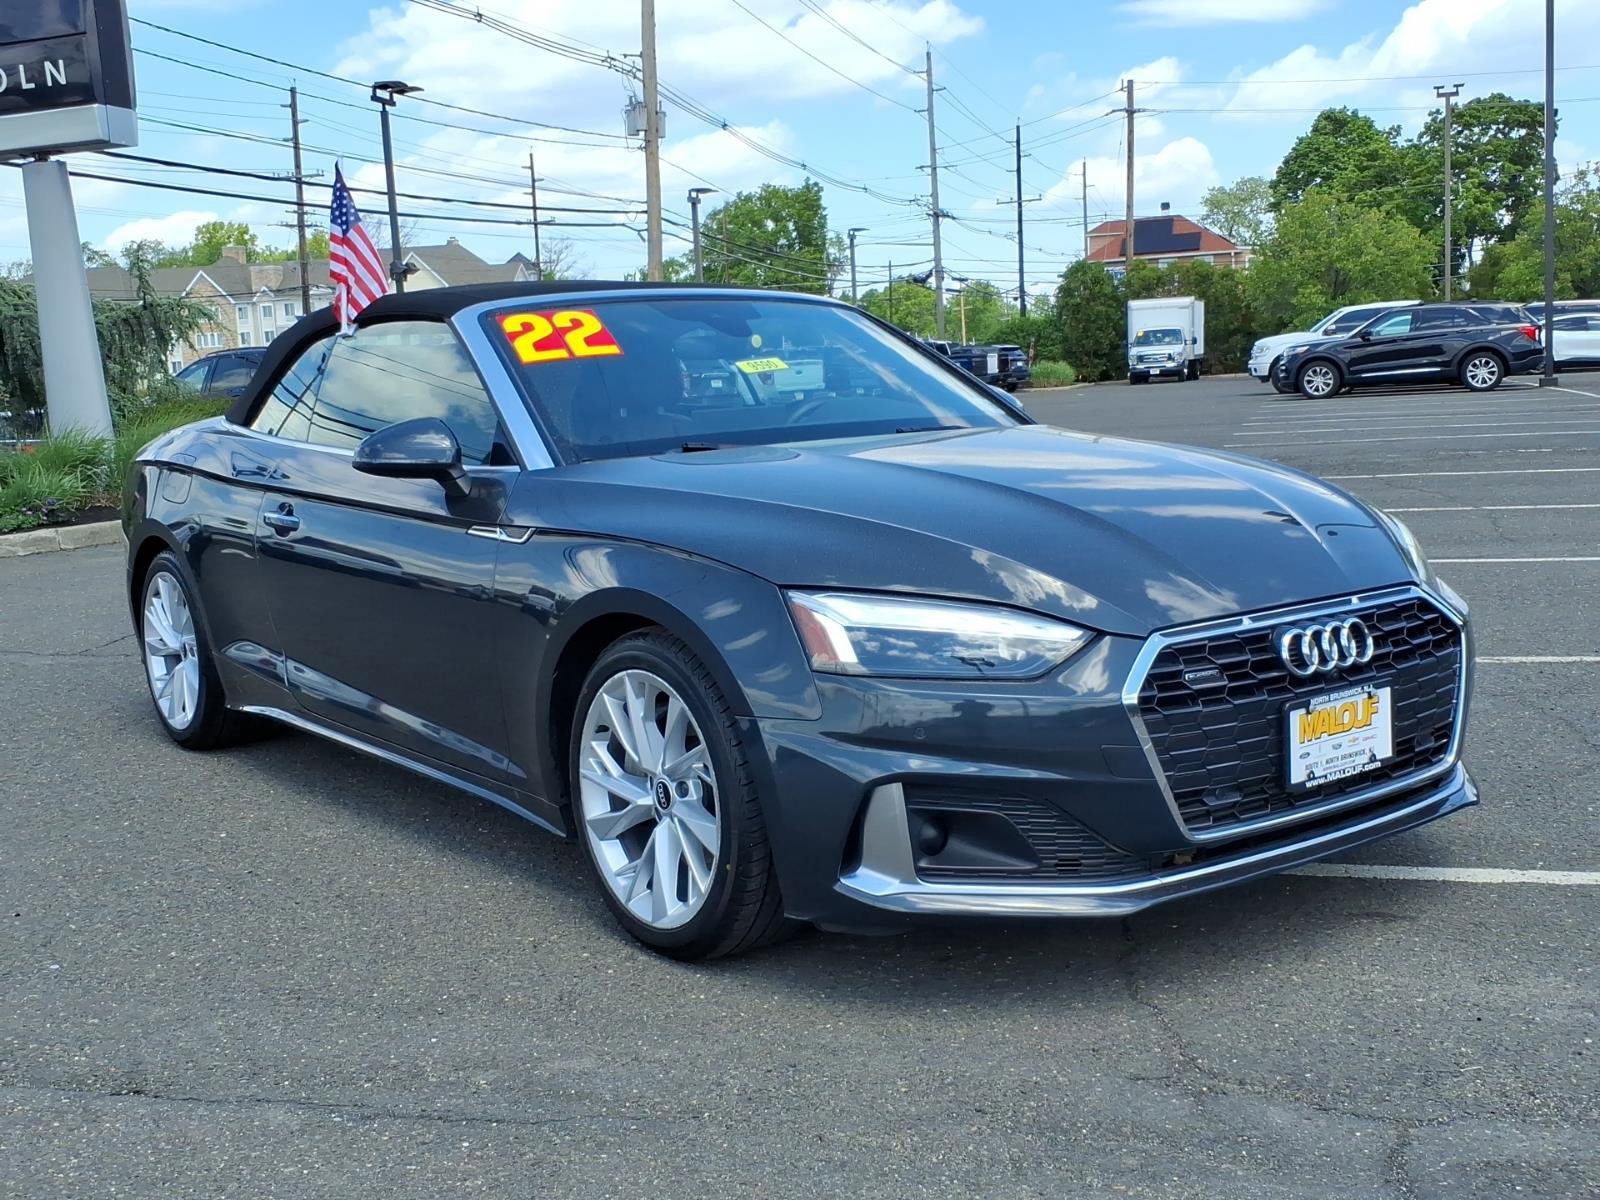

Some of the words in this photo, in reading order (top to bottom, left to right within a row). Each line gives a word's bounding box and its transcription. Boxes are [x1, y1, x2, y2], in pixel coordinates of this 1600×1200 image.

[502, 310, 621, 365] 22
[1310, 695, 1329, 705] NORTH
[1299, 695, 1379, 744] MALOUF
[1326, 755, 1339, 765] NORTH
[1305, 761, 1381, 788] www.MALOUF.com
